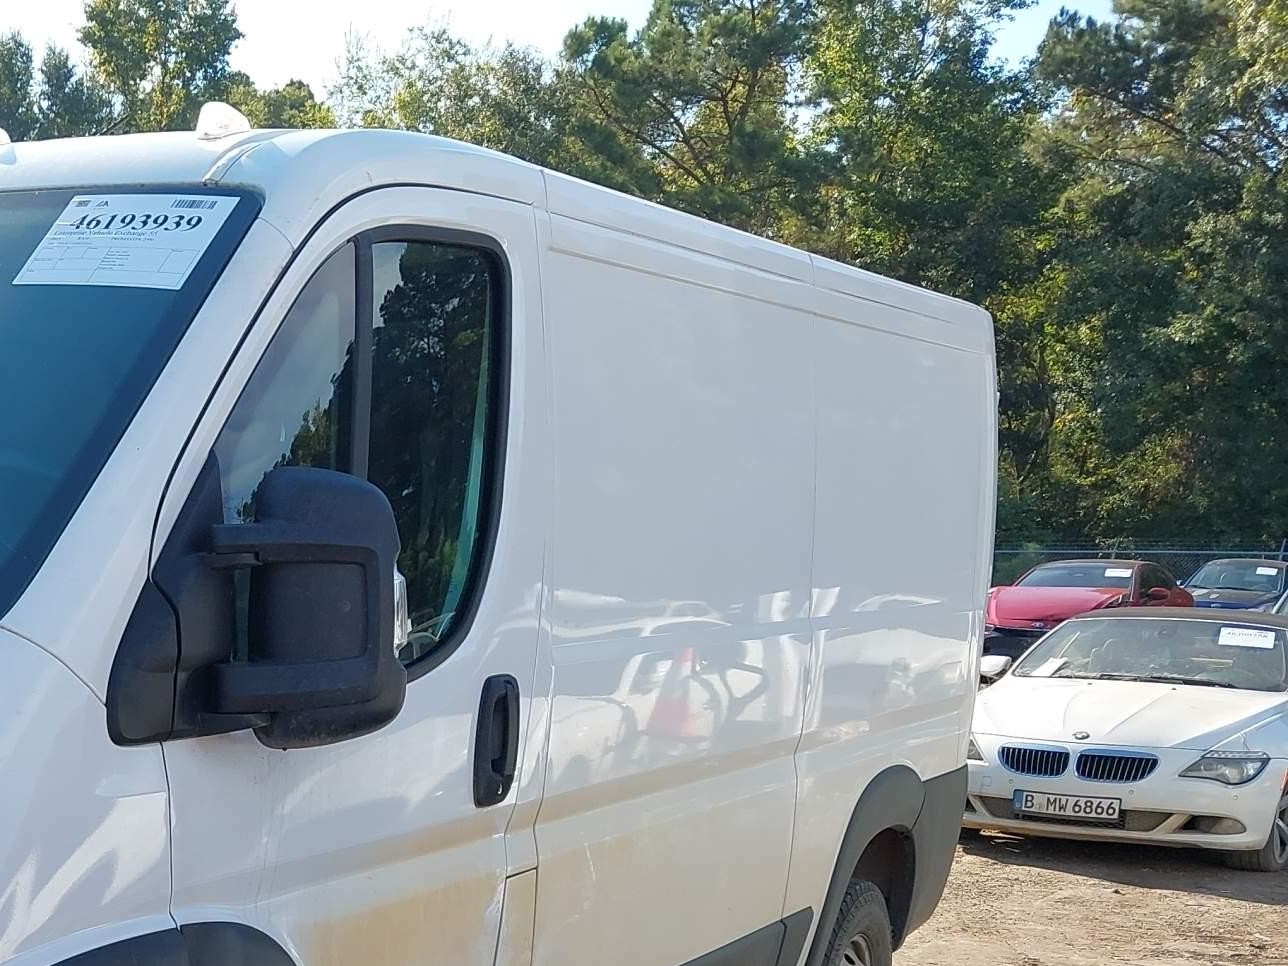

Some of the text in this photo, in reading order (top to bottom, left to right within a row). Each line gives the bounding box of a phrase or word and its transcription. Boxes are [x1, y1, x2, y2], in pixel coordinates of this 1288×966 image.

[72, 213, 203, 232] 46193939
[1024, 794, 1116, 816] B MW 6866
